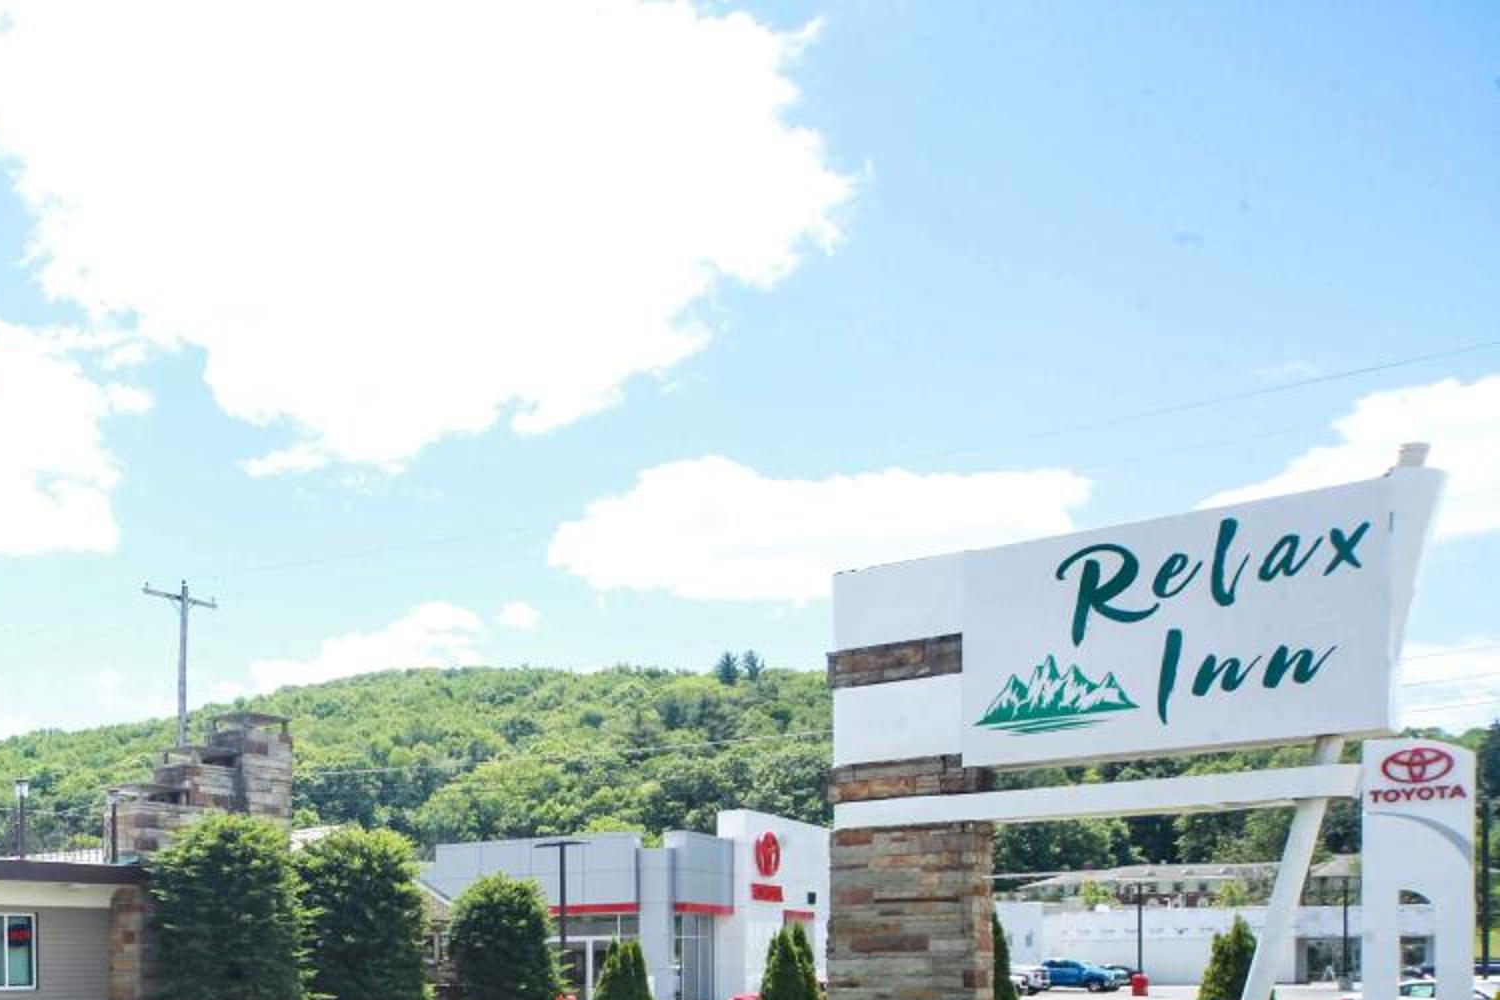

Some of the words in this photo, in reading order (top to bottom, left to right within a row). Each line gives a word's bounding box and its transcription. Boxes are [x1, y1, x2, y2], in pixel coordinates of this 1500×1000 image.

[1055, 517, 1372, 647] Relax
[1156, 628, 1338, 725] Inn
[1368, 784, 1467, 803] TOYOTA
